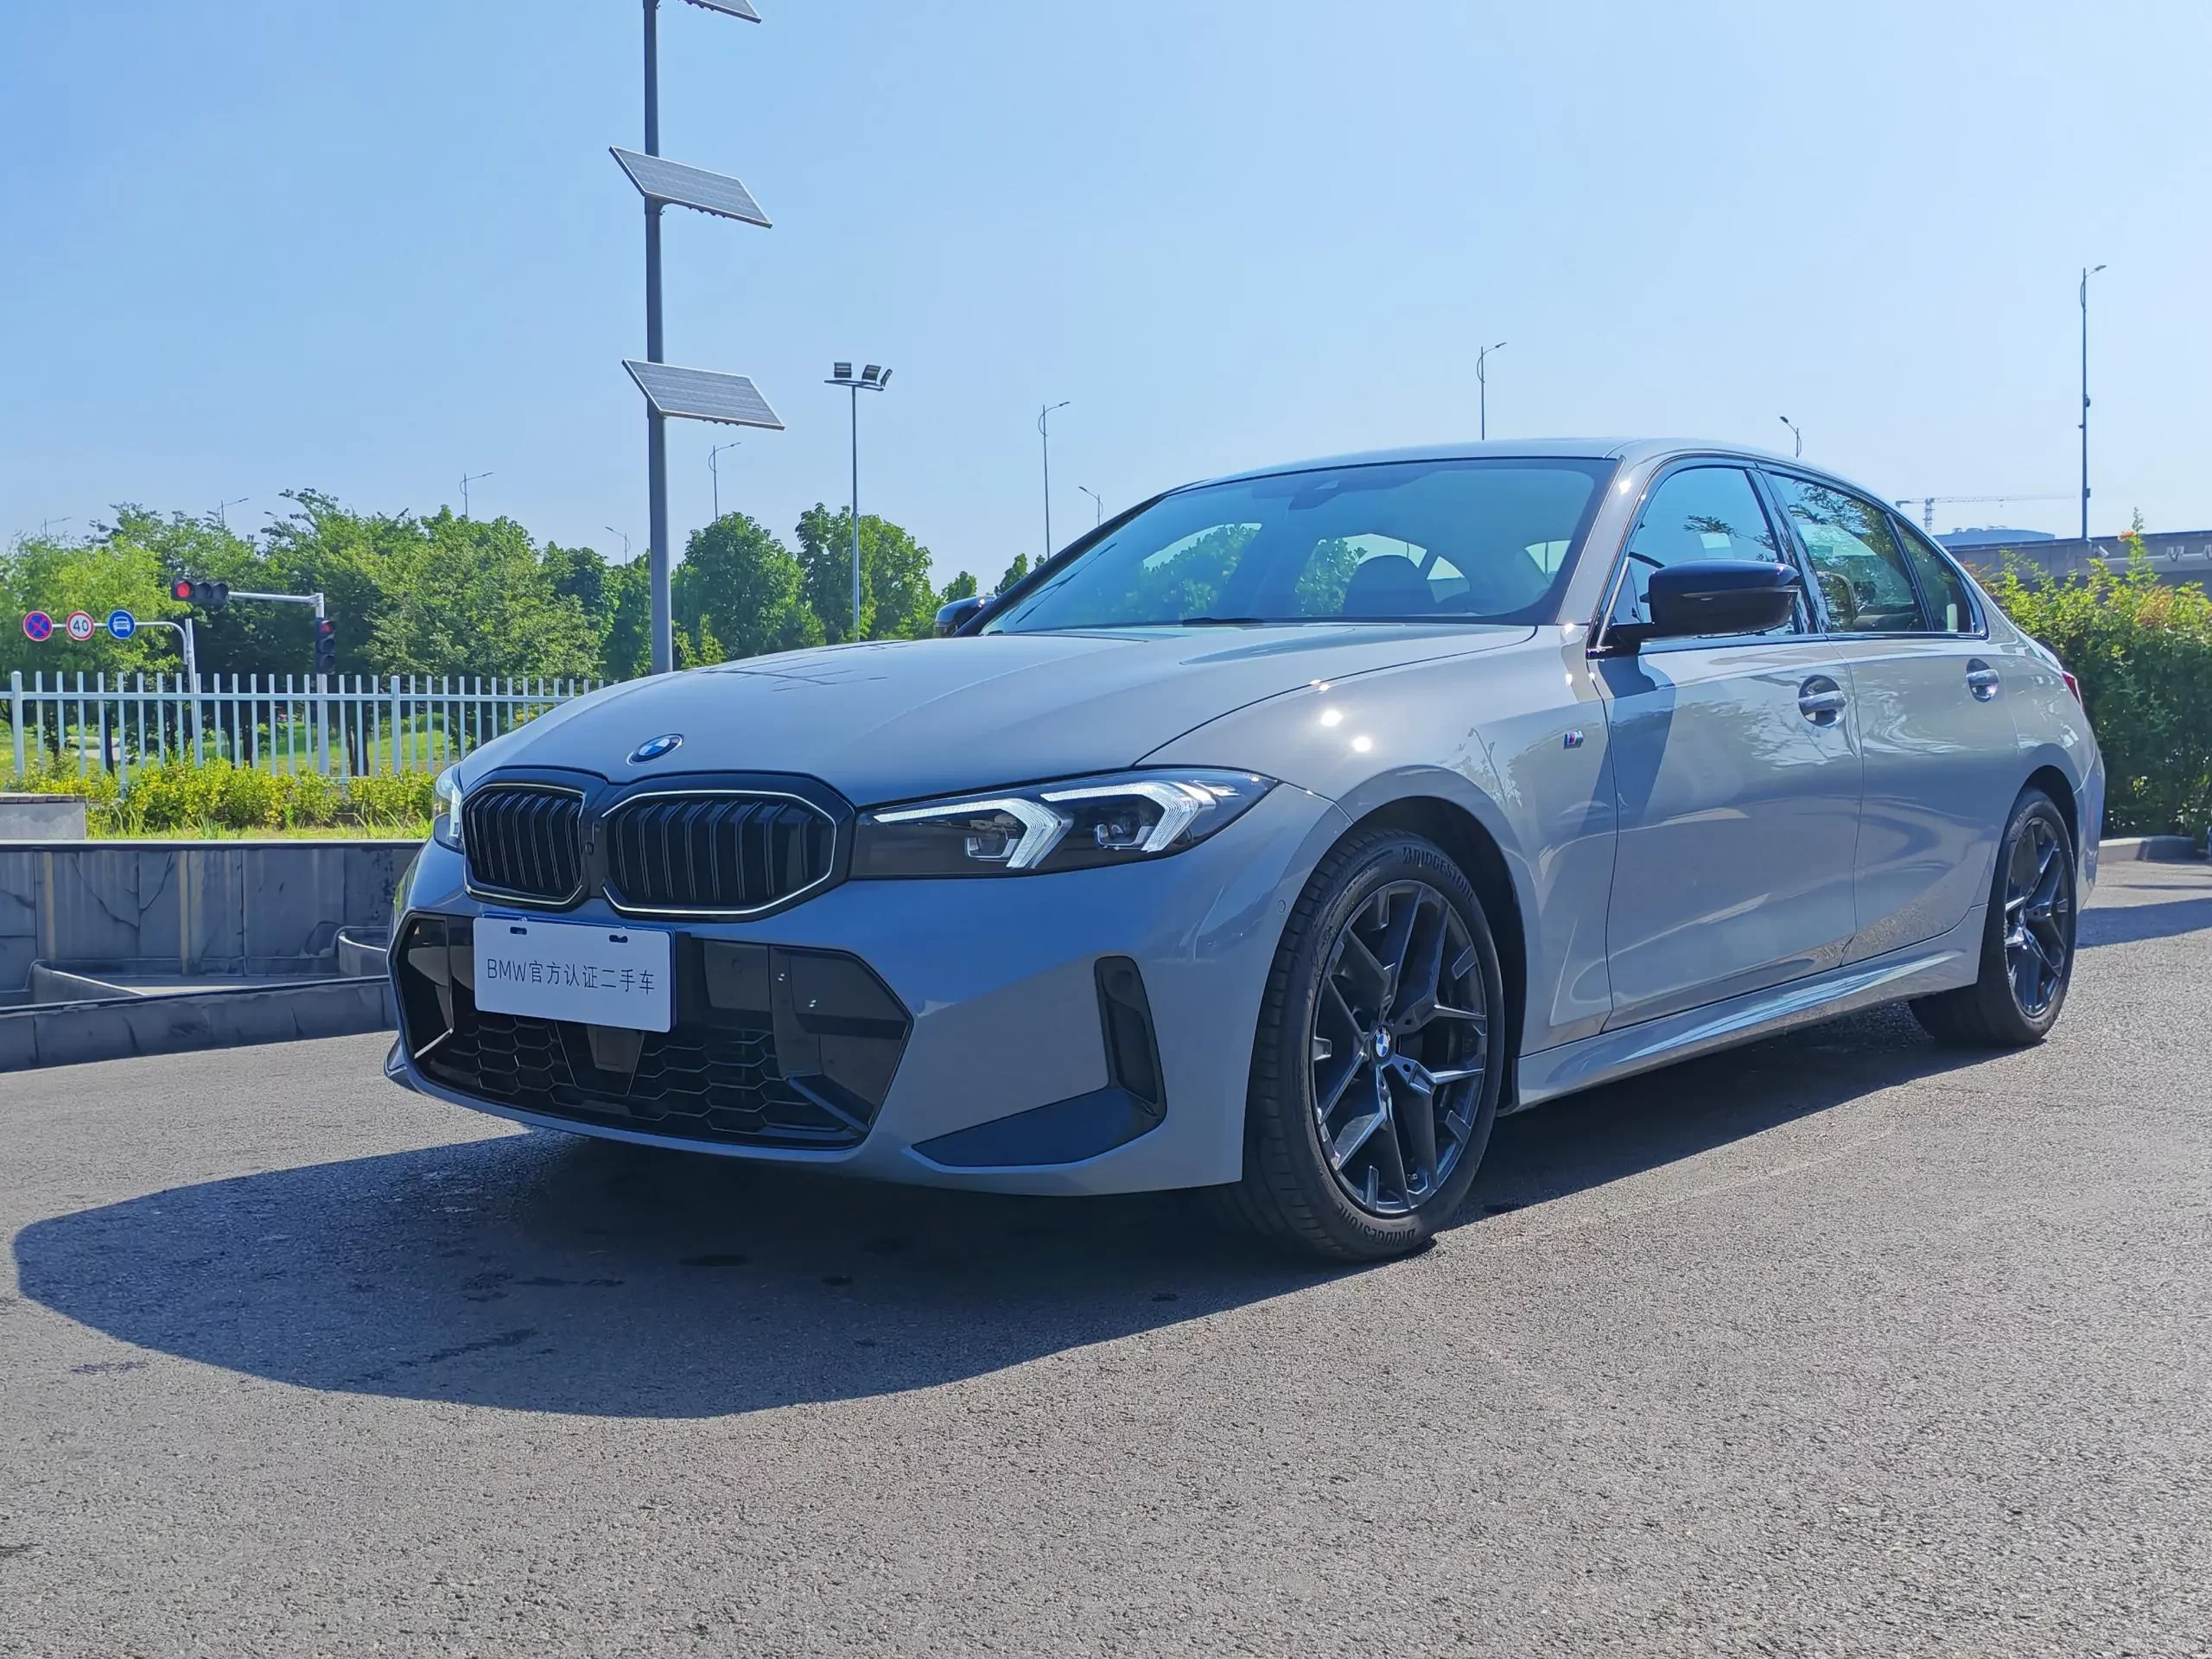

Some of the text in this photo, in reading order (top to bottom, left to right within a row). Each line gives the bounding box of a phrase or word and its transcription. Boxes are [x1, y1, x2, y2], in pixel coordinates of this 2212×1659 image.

[73, 620, 89, 632] 40
[487, 958, 655, 995] BMW官方认证二手车
